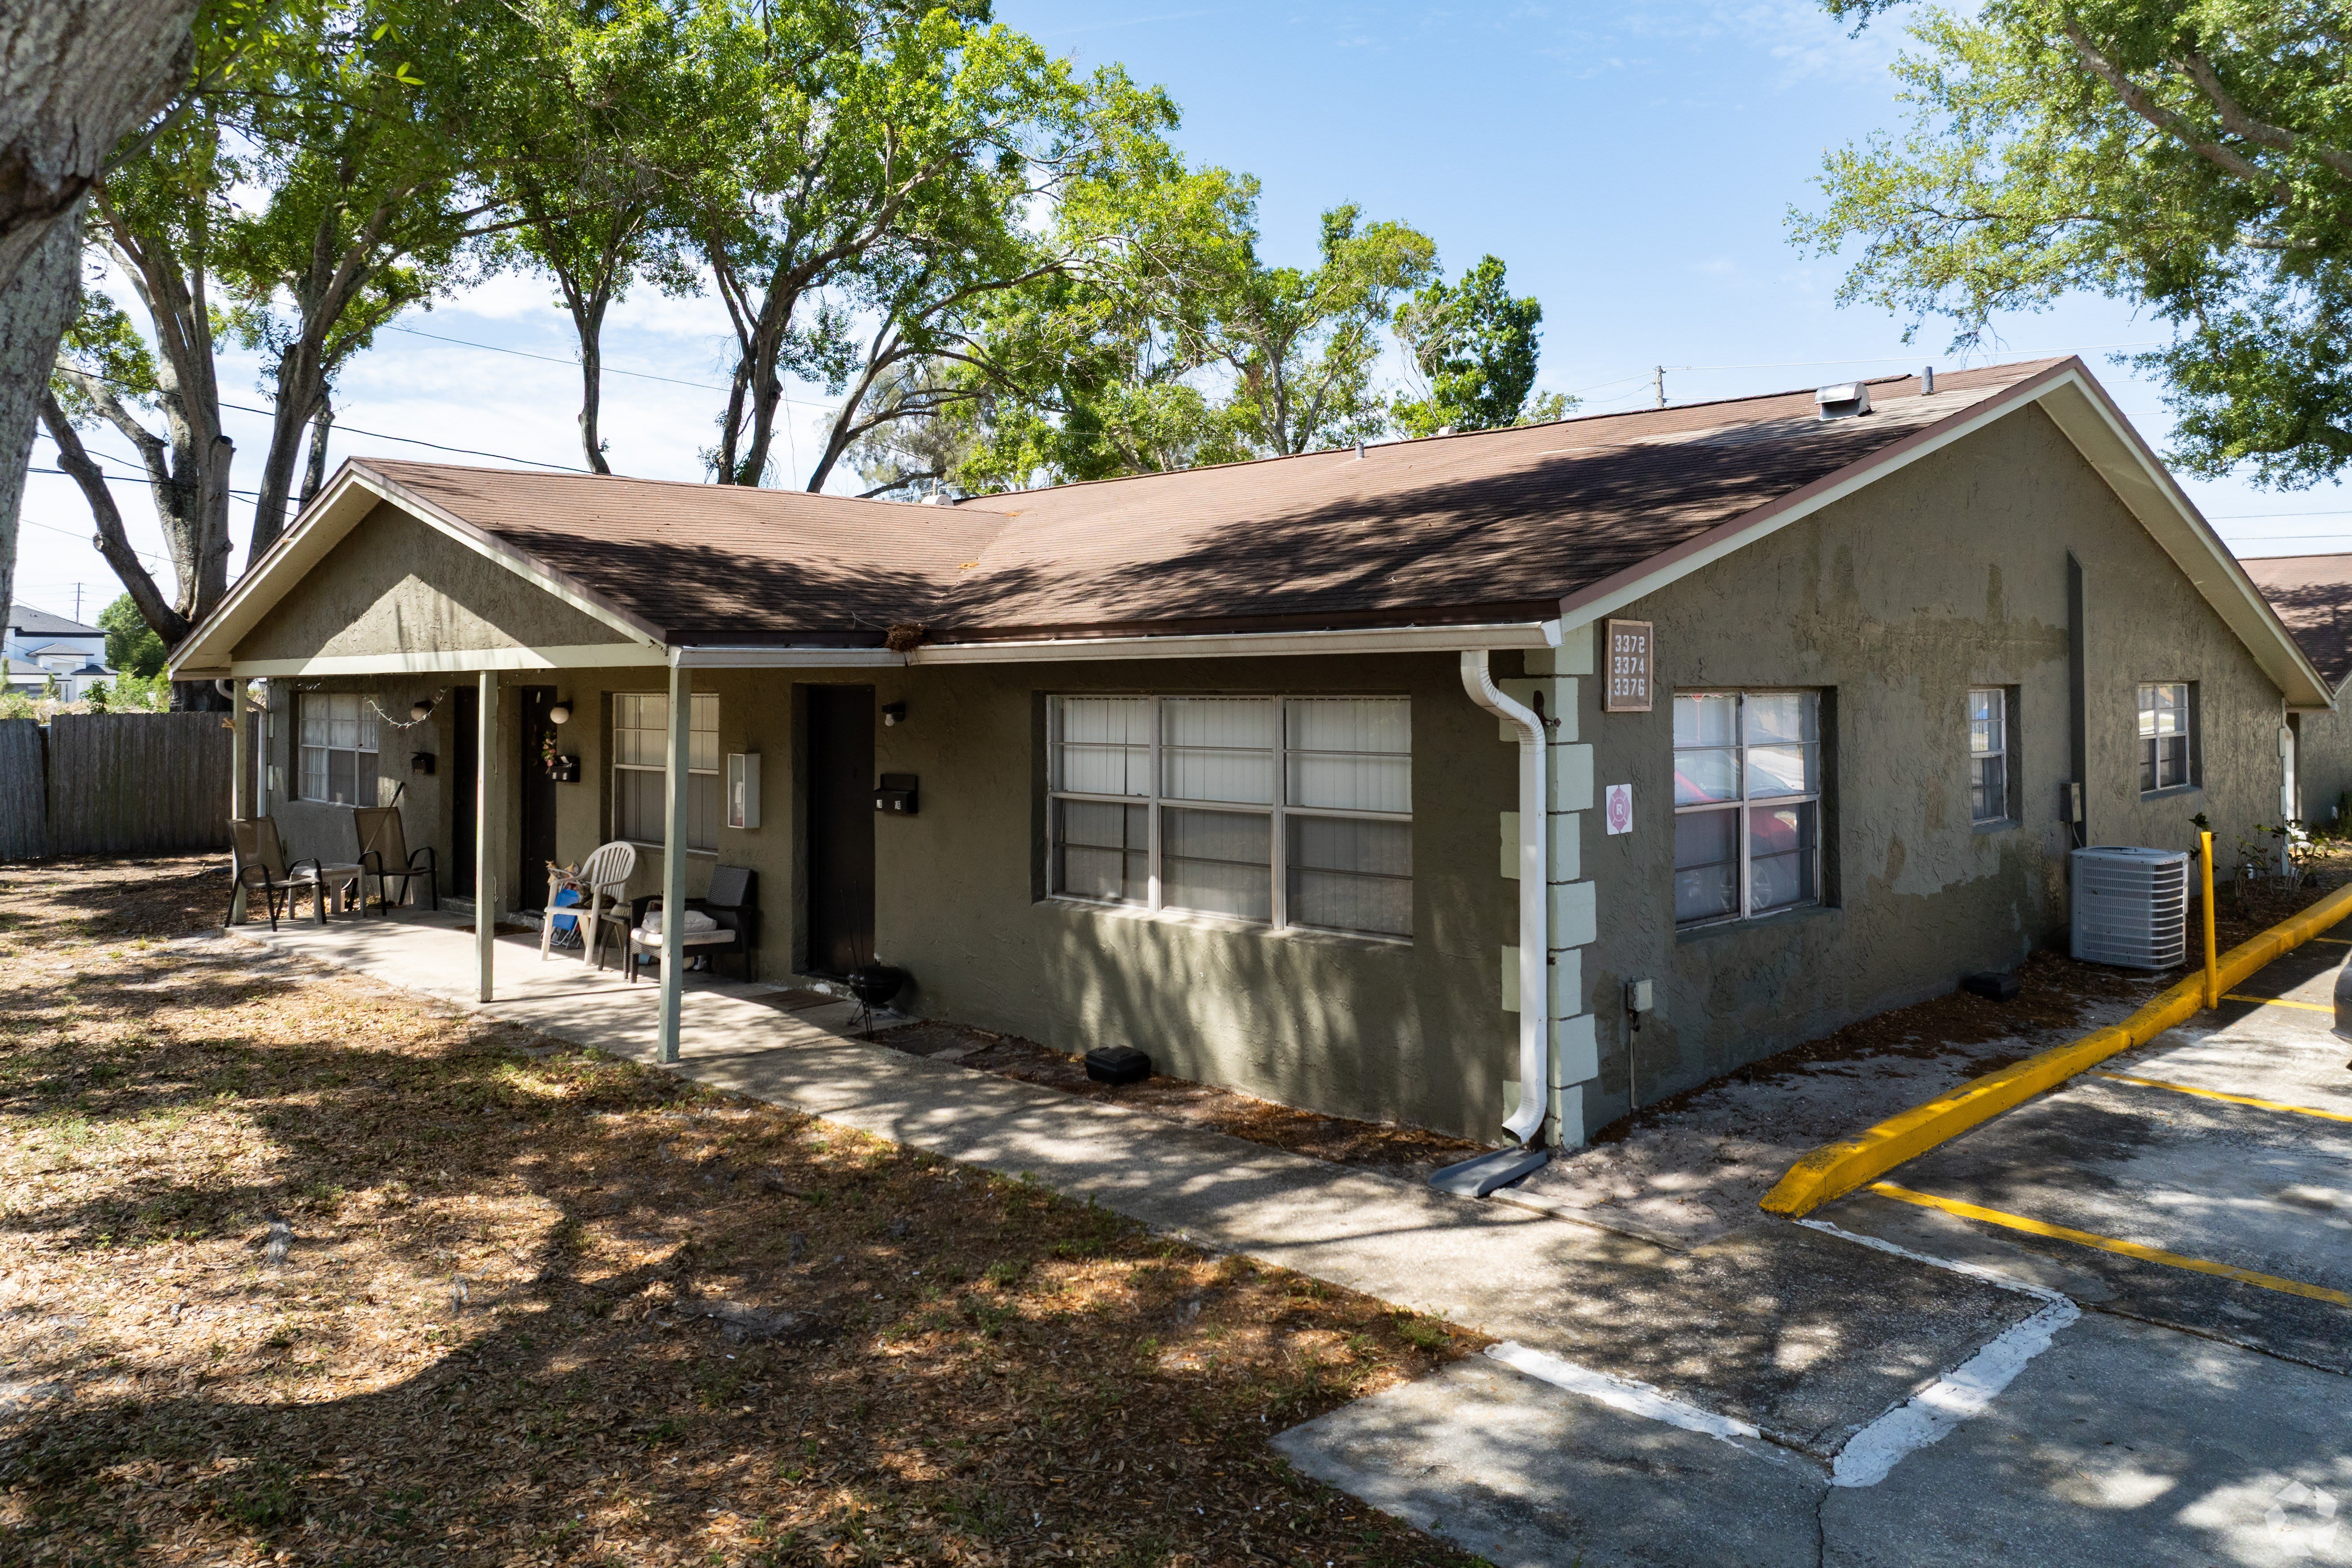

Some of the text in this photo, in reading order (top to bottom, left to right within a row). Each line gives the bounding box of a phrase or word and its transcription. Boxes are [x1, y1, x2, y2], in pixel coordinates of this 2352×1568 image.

[1615, 635, 1645, 654] 3372
[1615, 656, 1644, 674] 3374
[1614, 678, 1644, 696] 3376
[1616, 804, 1623, 815] R
